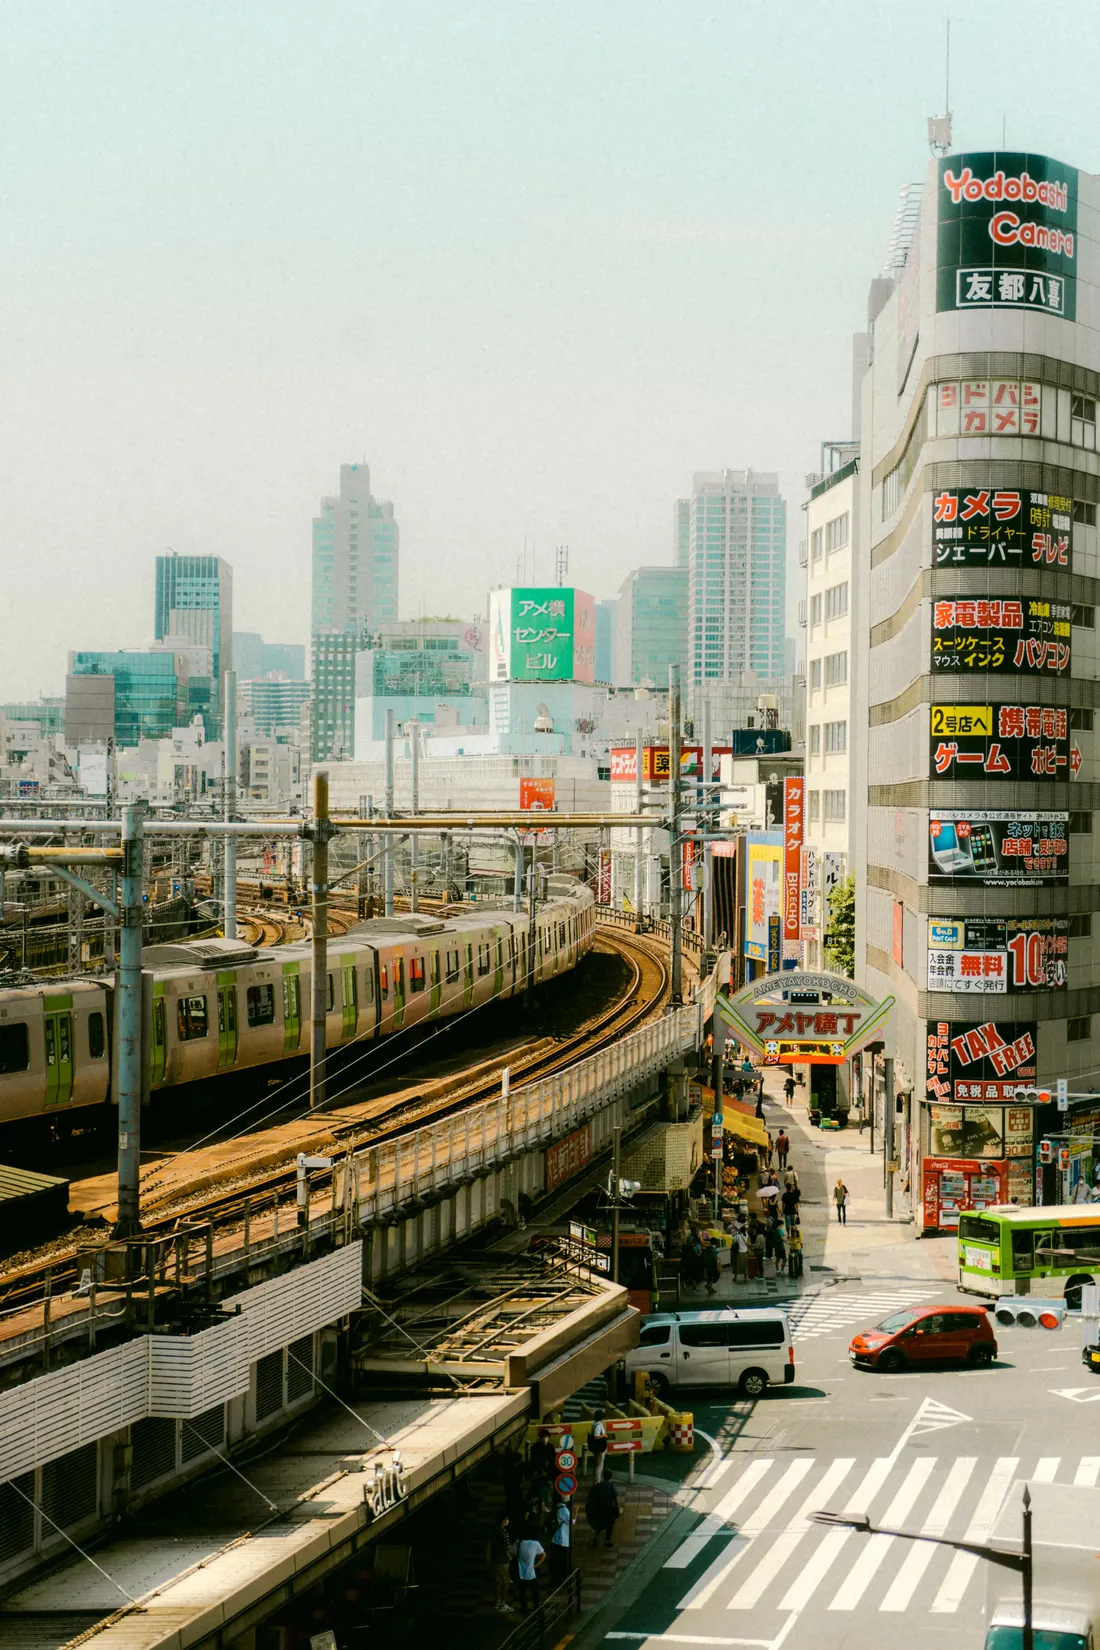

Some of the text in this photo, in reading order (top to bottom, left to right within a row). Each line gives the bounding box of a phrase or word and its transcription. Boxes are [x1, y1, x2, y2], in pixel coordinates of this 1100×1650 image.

[944, 167, 1068, 213] Yodobashi
[988, 210, 1074, 259] Camera
[965, 272, 1061, 309] 友都八喜
[939, 382, 1039, 408] ヨドバシ
[963, 410, 1039, 433] カメラ
[933, 490, 1022, 522] カメラ
[1030, 507, 1051, 529] 時計
[967, 525, 1027, 541] ドライヤー
[1032, 532, 1070, 567] テレビ
[518, 600, 566, 617] アメ横
[934, 600, 1024, 630] 家電製品
[513, 627, 571, 644] センター
[933, 636, 1006, 652] スーツケース
[526, 652, 558, 670] ビル
[933, 652, 1005, 668] マウス インク
[1013, 637, 1070, 671] パソコン
[933, 708, 988, 734] 2号店へ
[999, 705, 1067, 740] 携帯電話
[934, 742, 1012, 774] ゲーム
[1030, 746, 1068, 775] ホビー
[786, 786, 802, 852] カラオケ
[787, 872, 799, 930] BIG ECHO
[930, 953, 955, 965] 入会金
[930, 965, 955, 977] 年会費
[961, 954, 1004, 977] 無料
[753, 976, 858, 999] AMEYAYOKOCHO
[930, 979, 1005, 991] 店頭にてすぐ発行
[755, 1011, 862, 1036] アメヤ横丁
[928, 1034, 937, 1074] カメラ
[937, 1022, 949, 1075] ヨドバシ
[951, 1022, 1008, 1067] TAX
[989, 1031, 1036, 1078] FREE
[986, 1137, 1001, 1147] VISA
[560, 1455, 572, 1467] 30
